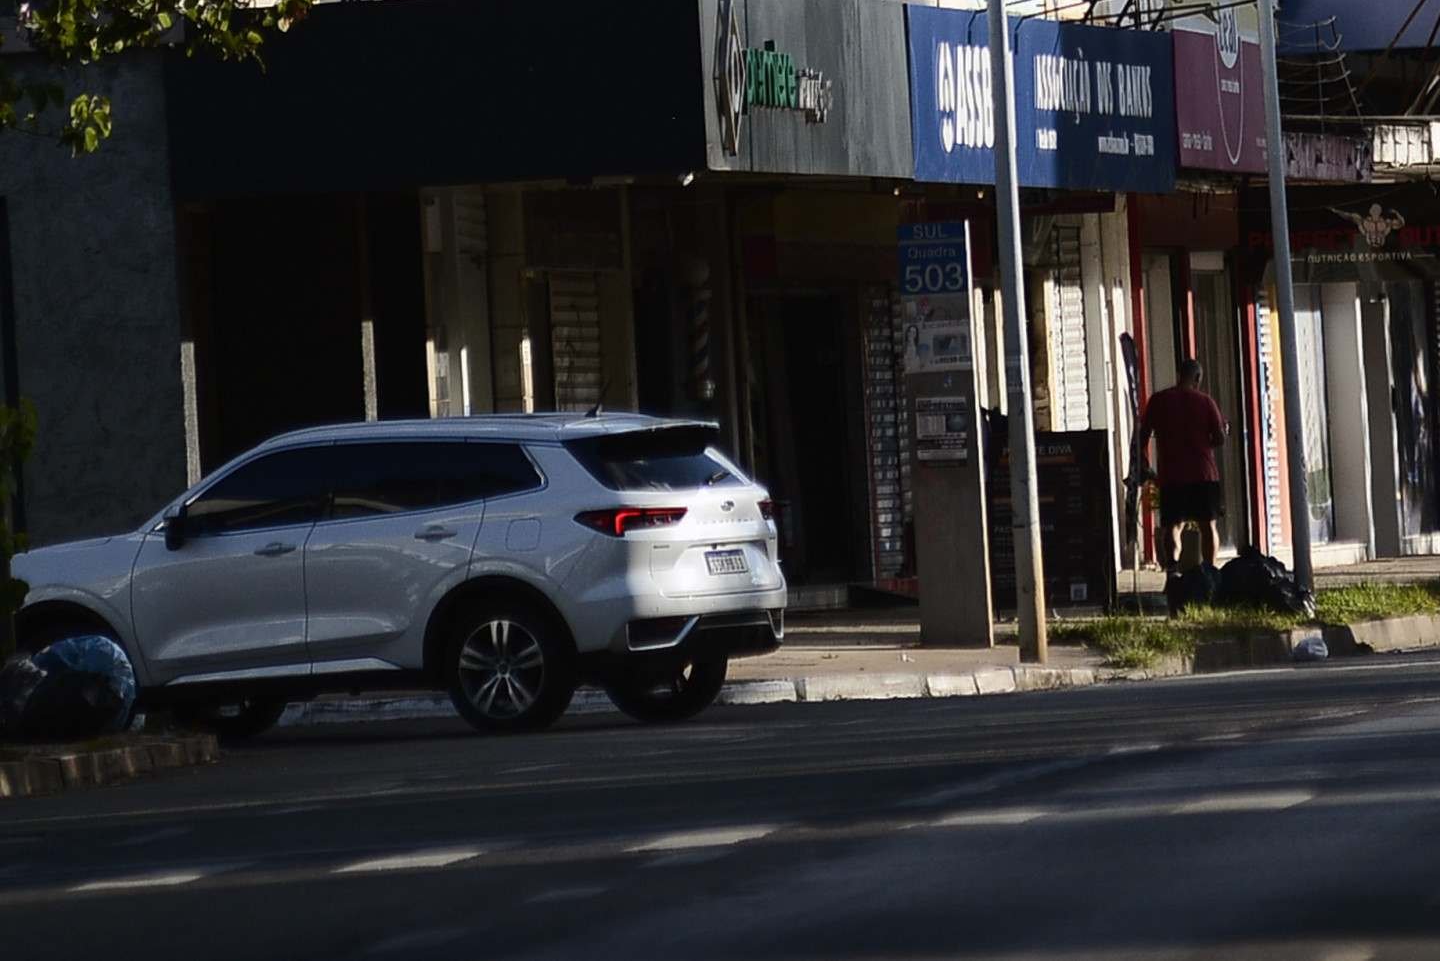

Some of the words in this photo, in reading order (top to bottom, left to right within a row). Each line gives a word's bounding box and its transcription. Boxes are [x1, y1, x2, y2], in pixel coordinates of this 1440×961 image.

[912, 224, 949, 240] SUL
[907, 245, 957, 260] Quadra
[904, 263, 964, 292] 503
